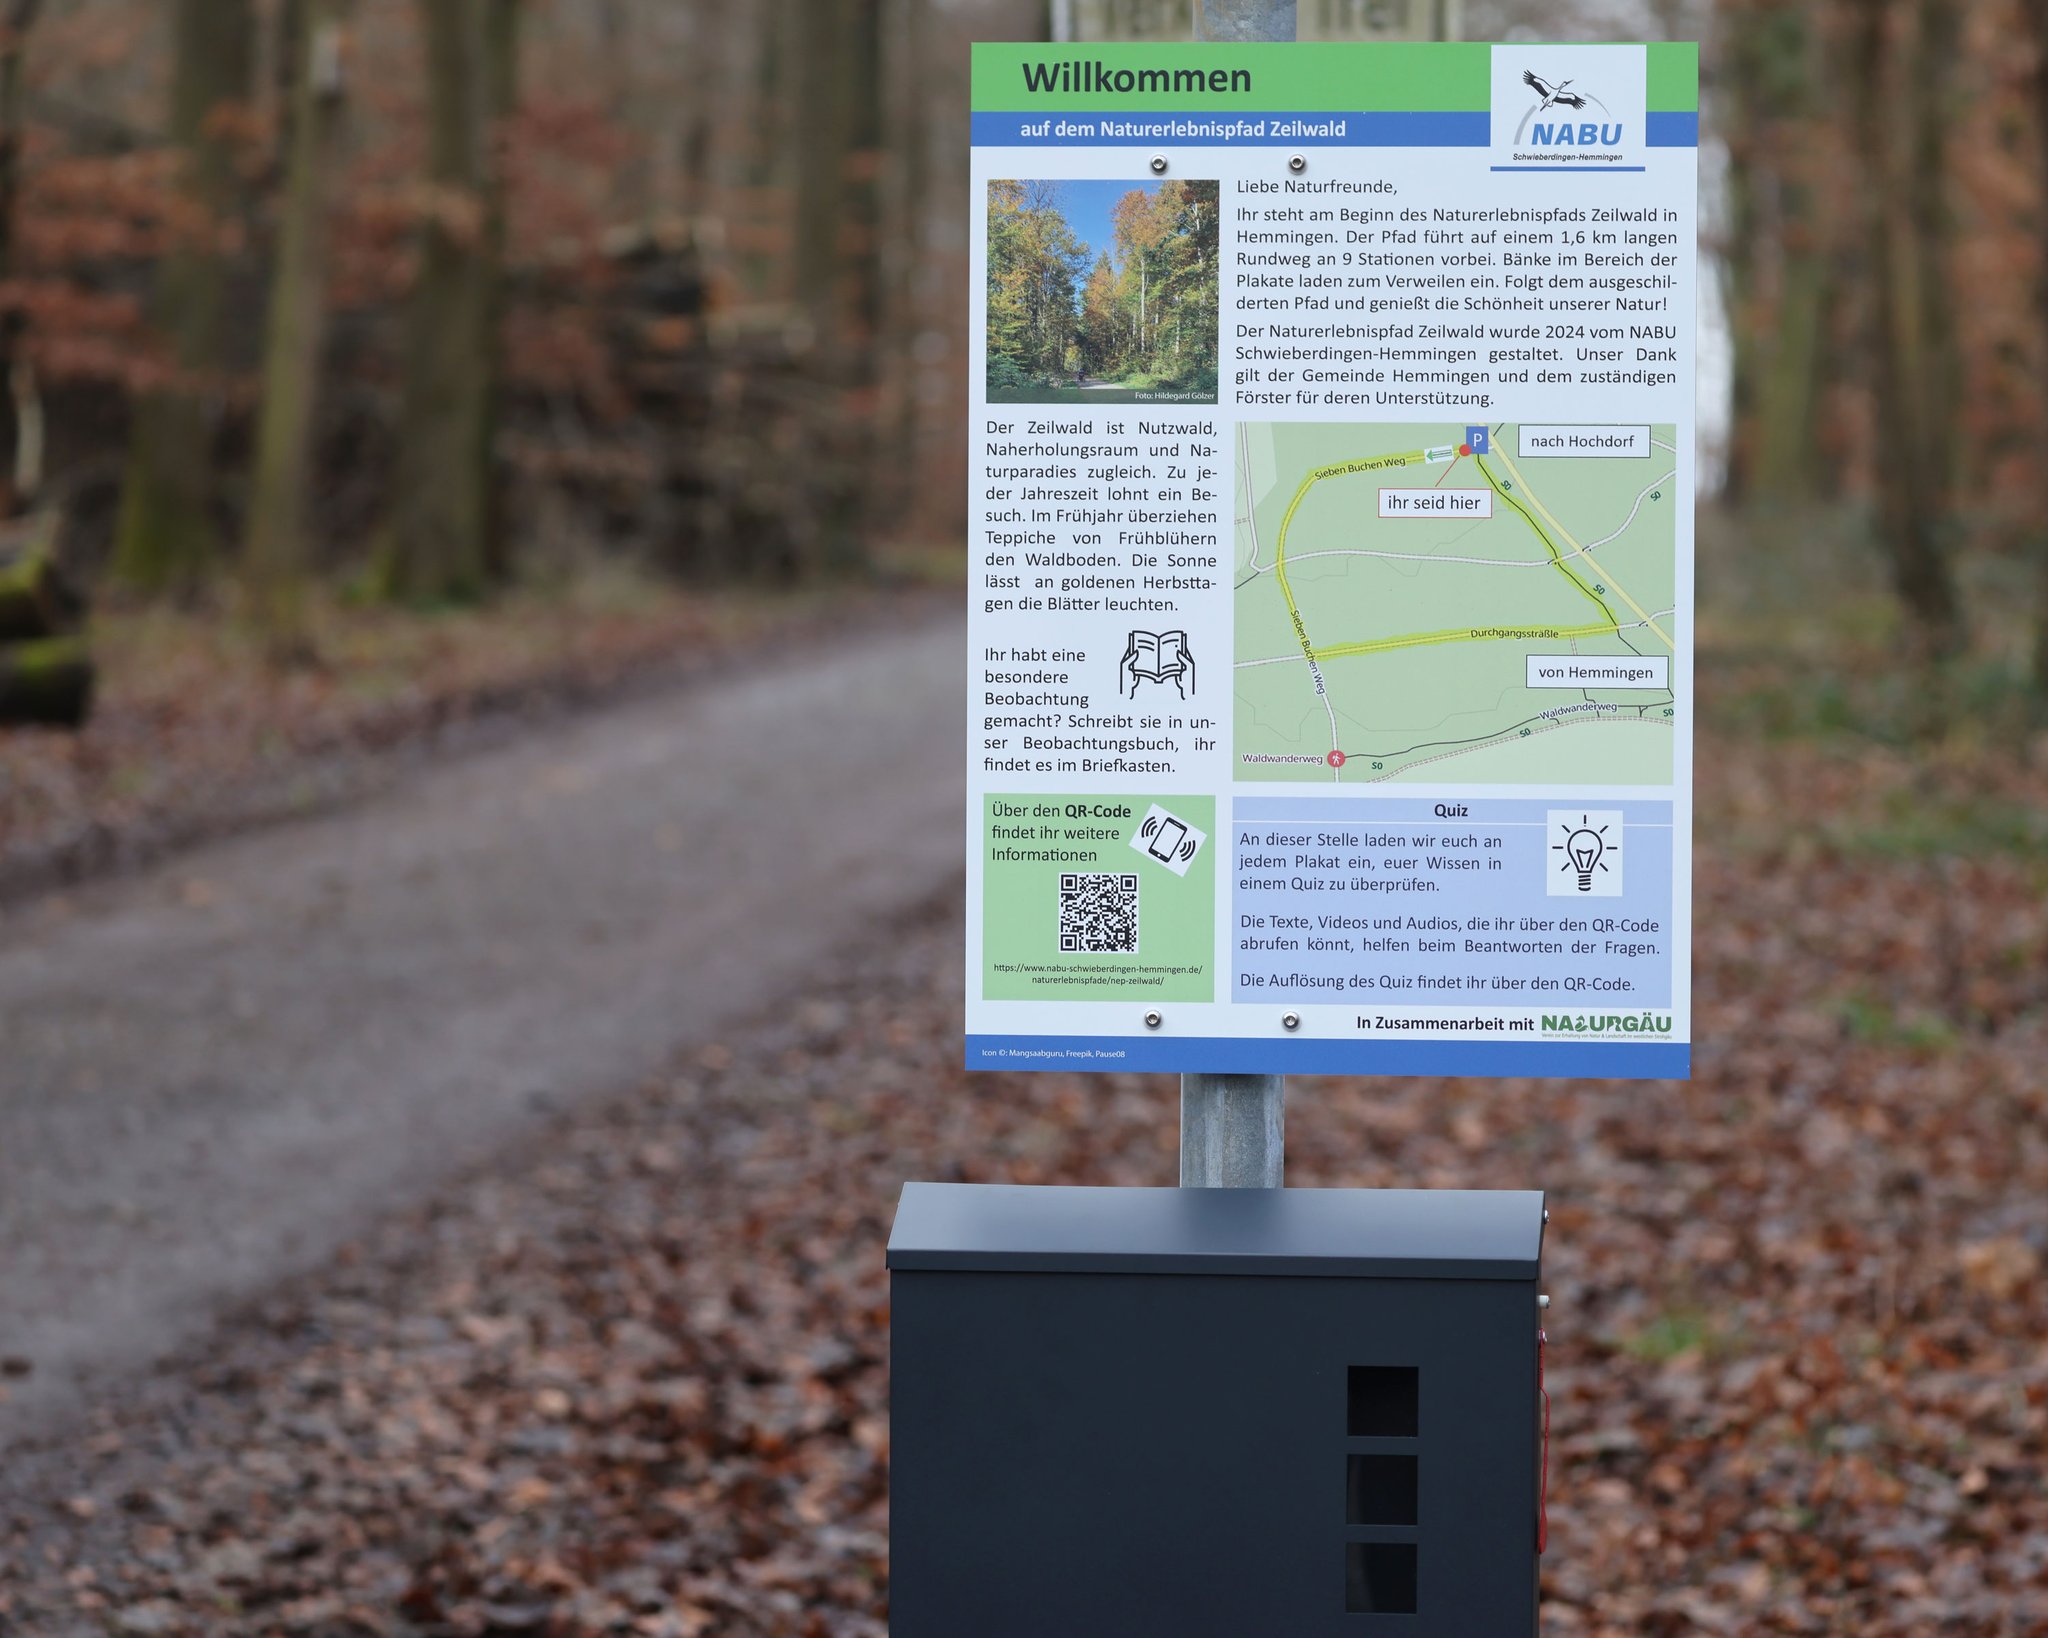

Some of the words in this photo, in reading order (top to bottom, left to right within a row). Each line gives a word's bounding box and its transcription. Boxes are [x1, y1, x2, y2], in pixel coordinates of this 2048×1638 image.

[1022, 61, 1250, 93] Willkommen
[1021, 120, 1050, 137] auf
[1055, 120, 1094, 137] dem
[1101, 120, 1264, 140] Naturerlebnispfad
[1270, 120, 1345, 137] Zeilwald
[1532, 124, 1622, 146] NABU
[1513, 152, 1622, 162] Schwieberdingen-Hemmingen
[1238, 179, 1279, 194] Liebe
[1285, 179, 1397, 196] Naturfreunde,
[1238, 207, 1258, 221] Ihr
[1264, 208, 1303, 222] steht
[1310, 211, 1333, 222] am
[1341, 208, 1393, 225] Beginn
[1400, 208, 1427, 222] des
[1434, 207, 1585, 225] Naturerlebnispfads
[1592, 207, 1657, 222] Zeilwald
[1664, 208, 1677, 222] in
[1238, 229, 1338, 247] Hemmingen.
[1347, 231, 1374, 244] Der
[1383, 230, 1416, 244] Pfad
[1424, 230, 1463, 244] führt
[1471, 229, 1497, 244] auf
[1504, 230, 1552, 244] einem
[1562, 230, 1585, 246] 1,6
[1593, 229, 1616, 244] km
[1625, 230, 1676, 247] langen
[1237, 324, 1264, 337] Der
[1270, 324, 1413, 341] Naturerlebnispfad
[1419, 324, 1483, 339] Zeilwald
[1490, 324, 1540, 339] wurde
[1546, 325, 1584, 339] 2024
[1590, 328, 1623, 339] vom
[1630, 325, 1675, 339] NABU
[1236, 345, 1476, 364] Schwieberdingen-Hemmingen
[1489, 347, 1562, 364] gestaltet.
[1577, 347, 1623, 361] Unser
[1637, 347, 1676, 361] Dank
[1135, 391, 1153, 400] Foto:
[1155, 392, 1190, 401] Hildegard
[1237, 390, 1291, 404] Förster
[1296, 390, 1319, 404] für
[1324, 391, 1369, 405] deren
[1376, 392, 1493, 408] Unterstützung.
[987, 420, 1014, 434] Der
[1028, 420, 1092, 435] Zeilwald
[1107, 421, 1124, 435] ist
[1139, 420, 1217, 438] Nutzwald,
[1474, 433, 1482, 447] P
[1532, 435, 1563, 448] nach
[1570, 435, 1634, 448] Hochdorf
[987, 442, 1137, 460] Naherholungsraum
[1150, 442, 1178, 456] und
[1191, 443, 1217, 457] Na-
[1314, 466, 1346, 481] Sieben
[1347, 461, 1383, 473] Buchen
[1384, 457, 1406, 469] Weg
[986, 485, 1012, 500] der
[1021, 486, 1098, 501] Jahreszeit
[1108, 486, 1148, 501] lohnt
[1158, 487, 1181, 501] ein
[1192, 487, 1217, 501] Be-
[1389, 495, 1409, 510] ihr
[1414, 495, 1444, 510] seid
[1451, 495, 1480, 510] hier
[985, 530, 1055, 547] Teppiche
[1073, 534, 1100, 545] von
[1120, 531, 1216, 545] Frühblühern
[1470, 628, 1559, 640] Durchgangssträßle
[986, 647, 1006, 661] Ihr
[1012, 647, 1046, 662] habt
[1052, 648, 1085, 662] eine
[1291, 609, 1307, 641] Sieben
[1301, 640, 1318, 673] Buchen
[1314, 673, 1325, 695] Weg
[986, 669, 1068, 684] besondere
[1539, 668, 1563, 678] von
[1570, 666, 1652, 682] Hemmingen
[986, 691, 1088, 709] Beobachtung
[1539, 702, 1618, 720] Waldwanderweg
[984, 713, 1061, 731] gemacht?
[1069, 713, 1133, 728] Schreibt
[1140, 715, 1161, 729] sie
[1169, 715, 1182, 729] in
[1191, 719, 1215, 729] un-
[985, 739, 1008, 749] ser
[1024, 735, 1178, 753] Beobachtungsbuch,
[1195, 737, 1215, 751] ihr
[984, 757, 1030, 772] findet
[1036, 761, 1052, 772] es
[1058, 758, 1076, 772] im
[1083, 758, 1175, 773] Briefkasten.
[1242, 754, 1323, 765] Waldwanderweg
[993, 800, 1028, 817] Über
[1033, 803, 1059, 817] den
[1065, 804, 1131, 819] QR-Code
[1435, 803, 1468, 819] Quiz
[992, 824, 1035, 839] findet
[1041, 825, 1059, 839] ihr
[1064, 826, 1119, 840] weitere
[1240, 833, 1259, 846] An
[1266, 832, 1311, 846] dieser
[1318, 832, 1358, 846] Stelle
[1365, 832, 1405, 847] laden
[1412, 834, 1435, 848] wir
[1442, 834, 1477, 848] euch
[1484, 837, 1501, 848] an
[993, 847, 1096, 862] Informationen
[1239, 854, 1286, 870] jedem
[1296, 854, 1340, 869] Plakat
[1349, 855, 1375, 871] ein,
[1384, 858, 1418, 870] euer
[1427, 856, 1479, 870] Wissen
[1489, 856, 1501, 870] in
[1240, 877, 1285, 890] einem
[1292, 877, 1324, 892] Quiz
[1330, 880, 1345, 891] zu
[1351, 876, 1439, 894] überprüfen.
[1241, 936, 1298, 950] abrufen
[1308, 937, 1353, 953] könnt,
[1364, 937, 1409, 951] helfen
[1419, 938, 1455, 952] beim
[1465, 939, 1562, 954] Beantworten
[1571, 940, 1596, 954] der
[1606, 940, 1659, 957] Fragen.
[993, 963, 1203, 975] https://www.nabu-schwieberdingen-hemmingen.de/
[1031, 975, 1164, 986] naturerlebnispfade/nep-zeilwald/
[1241, 973, 1264, 987] Die
[1269, 973, 1344, 991] Auflösung
[1349, 974, 1374, 988] des
[1380, 975, 1412, 989] Quiz
[1418, 974, 1461, 989] findet
[1467, 975, 1486, 989] ihr
[1492, 975, 1526, 990] über
[1531, 975, 1558, 991] den
[1564, 977, 1634, 992] QR-Code.
[1358, 1015, 1370, 1029] In
[1376, 1016, 1504, 1031] Zusammenarbeit
[1510, 1018, 1534, 1031] mit
[1541, 1012, 1672, 1033] NAURGÄU
[1066, 1050, 1094, 1059] Freepik,
[1096, 1050, 1125, 1058] Pause08
